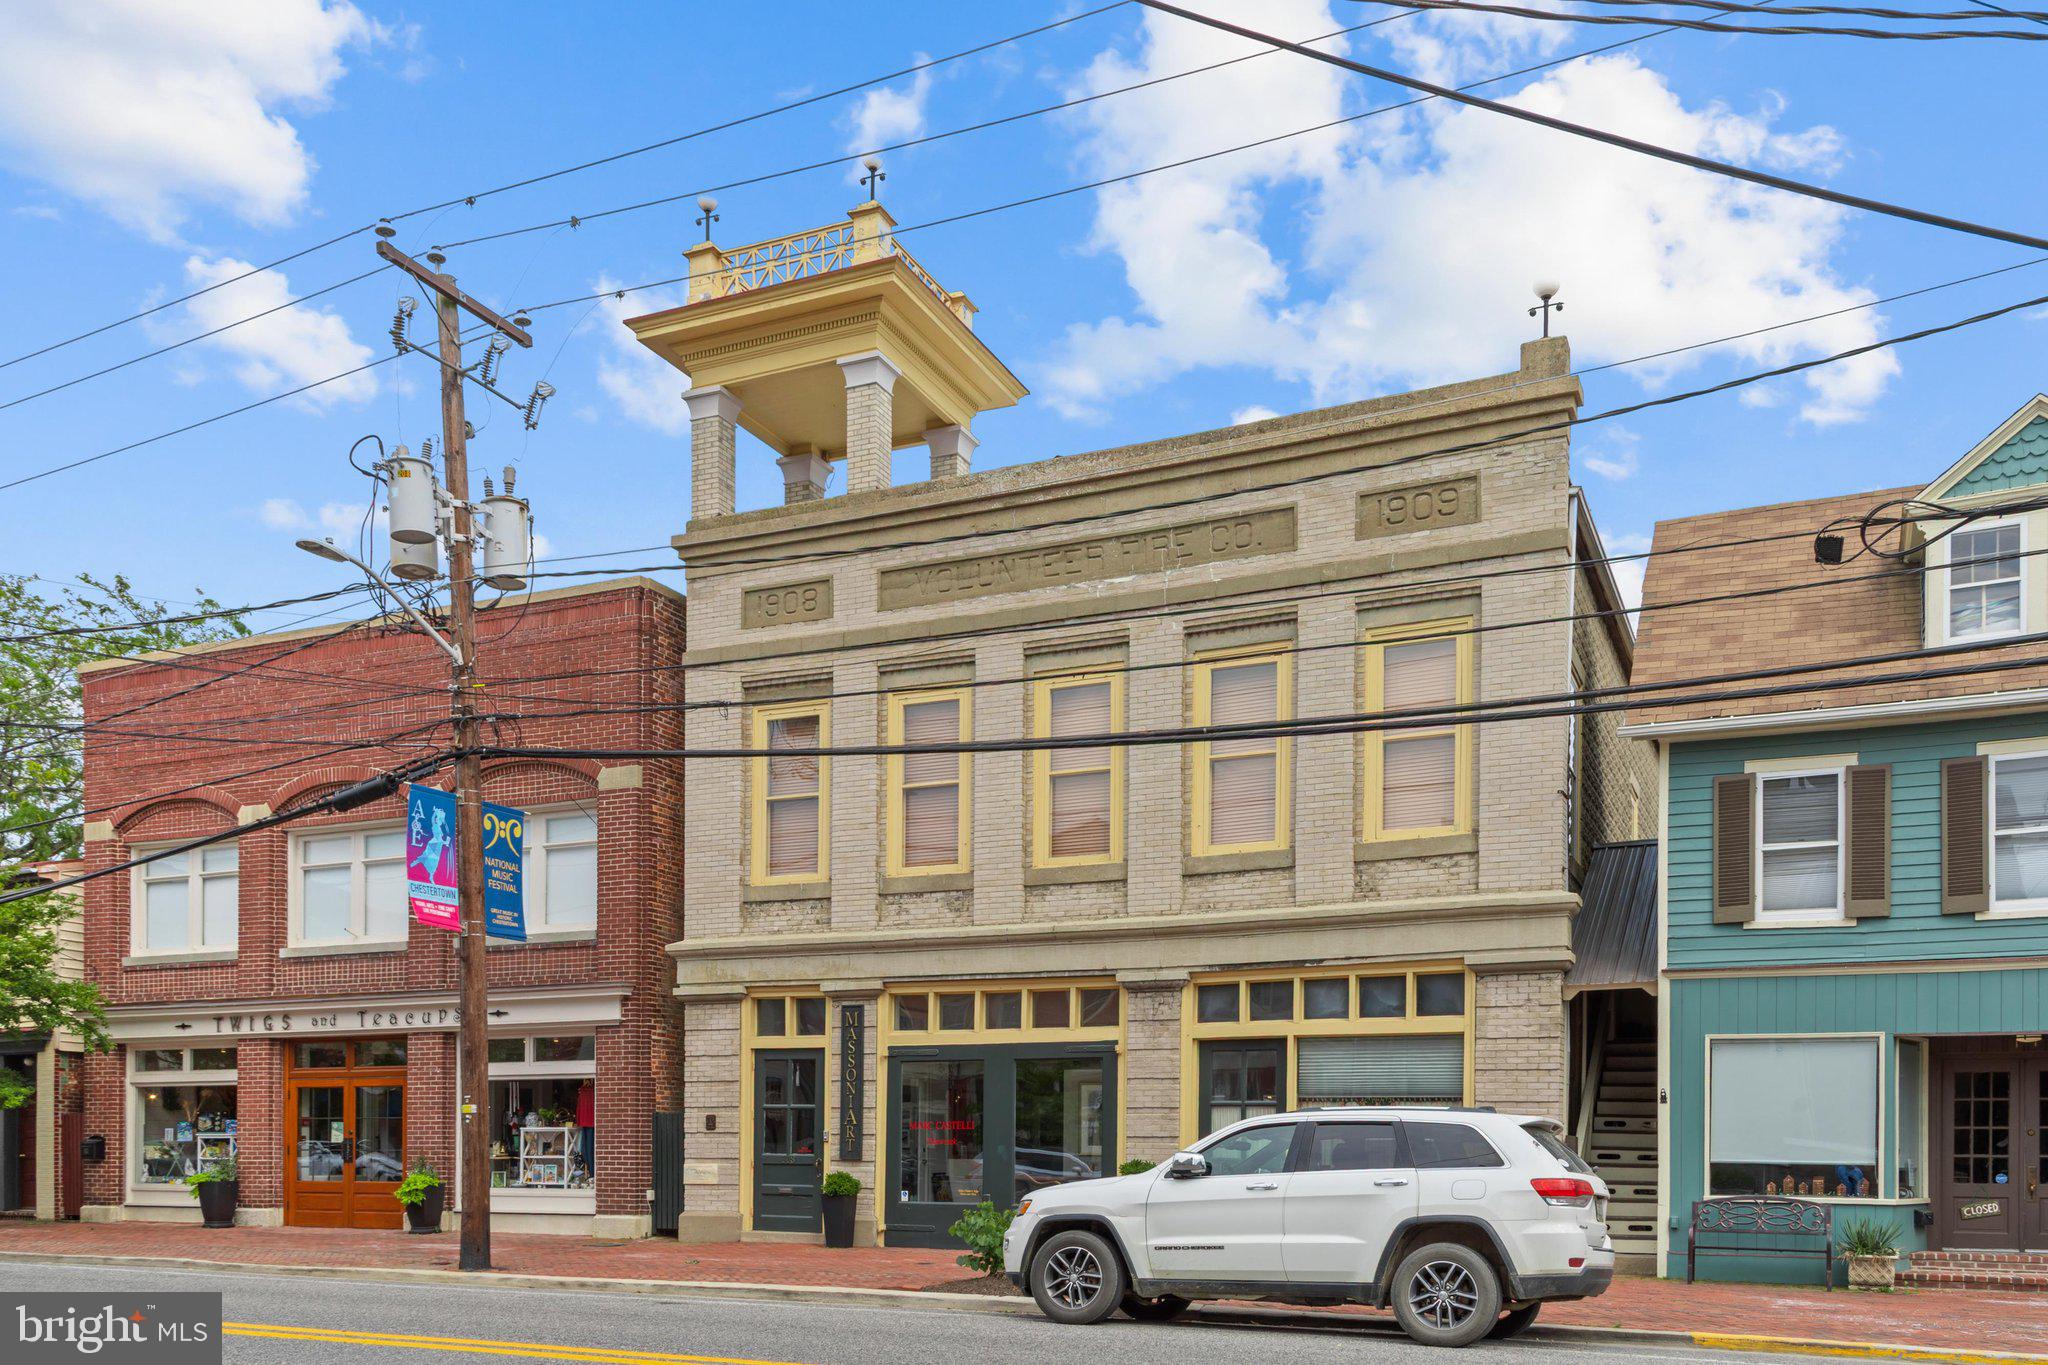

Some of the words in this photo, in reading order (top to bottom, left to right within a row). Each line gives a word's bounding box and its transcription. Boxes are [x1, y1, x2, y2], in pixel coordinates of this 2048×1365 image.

[1378, 488, 1459, 527] 1909
[914, 544, 1104, 595] VOLUNTEER
[1121, 530, 1194, 568] FIRE
[1210, 521, 1263, 553] CO.
[757, 589, 818, 618] 1908
[485, 857, 520, 872] NATIONAL
[492, 869, 513, 882] MUSIC
[410, 883, 456, 899] CHESTERTOWN
[488, 879, 518, 893] FESTIVAL
[213, 1014, 292, 1034] TWIGS
[311, 1013, 337, 1027] and
[1963, 1203, 1999, 1216] CLOSED
